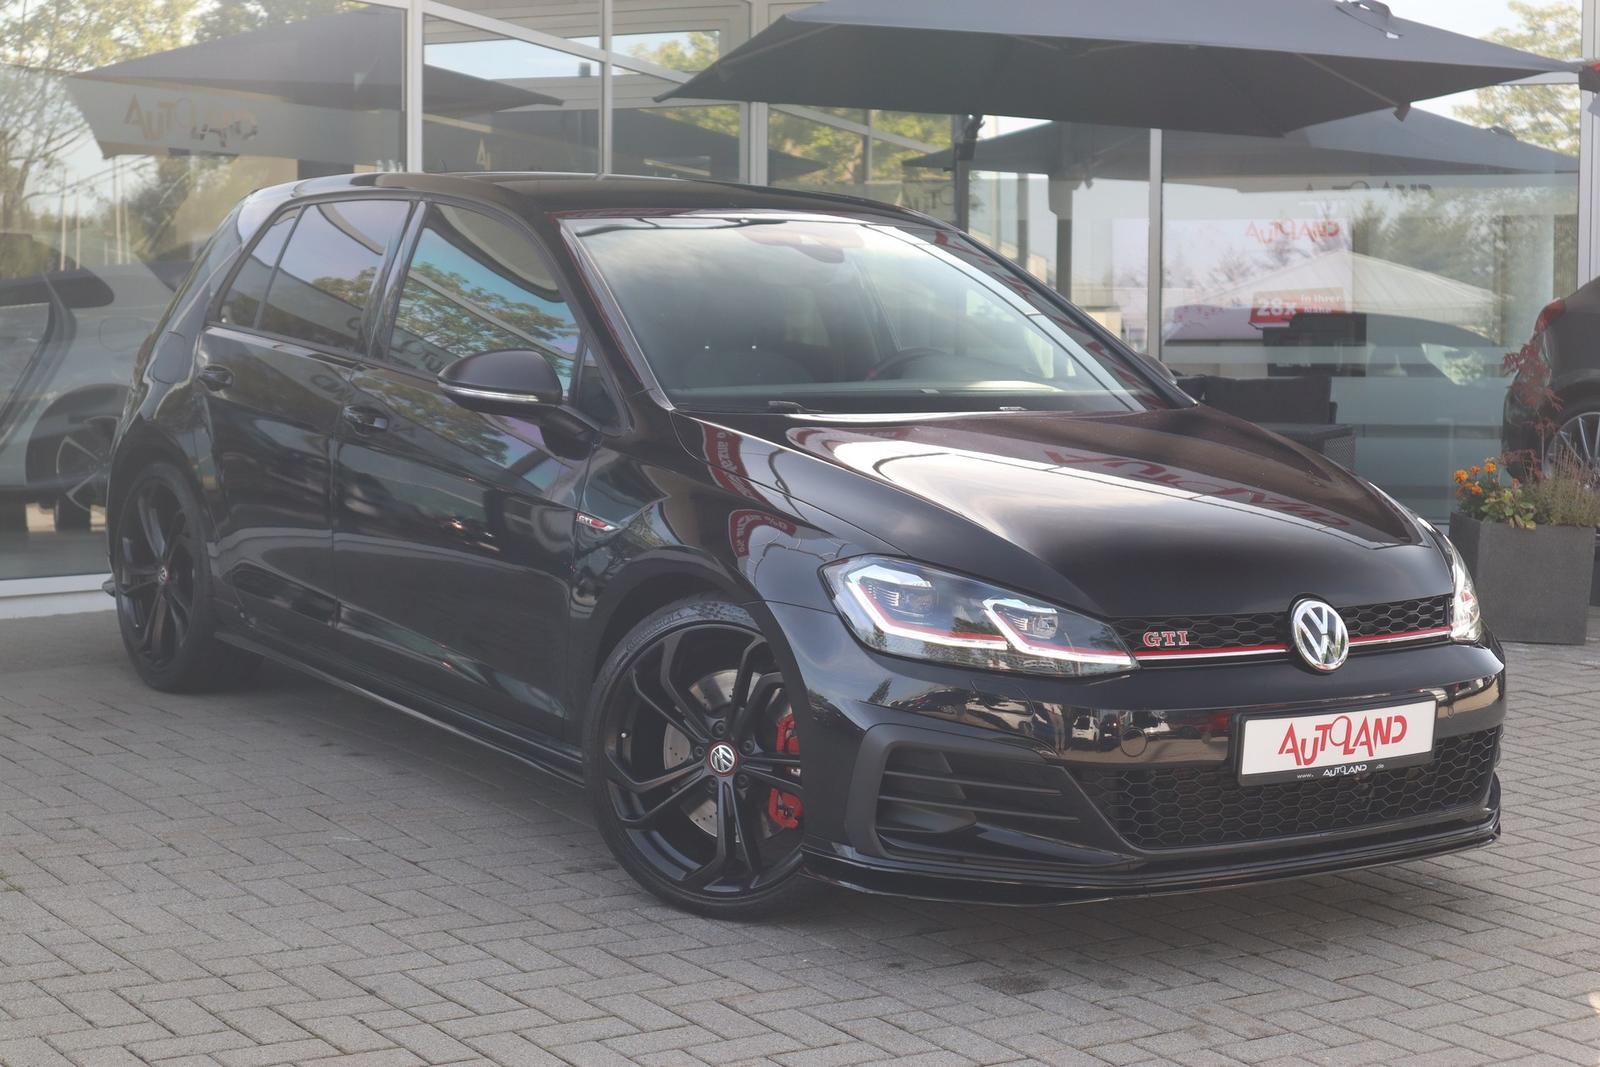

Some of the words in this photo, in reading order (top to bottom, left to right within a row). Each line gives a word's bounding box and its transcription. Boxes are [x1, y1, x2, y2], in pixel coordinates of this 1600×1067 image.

[1257, 297, 1298, 317] 28x
[1143, 631, 1190, 647] GTI
[1278, 715, 1408, 766] AUTOLAND
[1322, 764, 1368, 777] AUTOLAND
